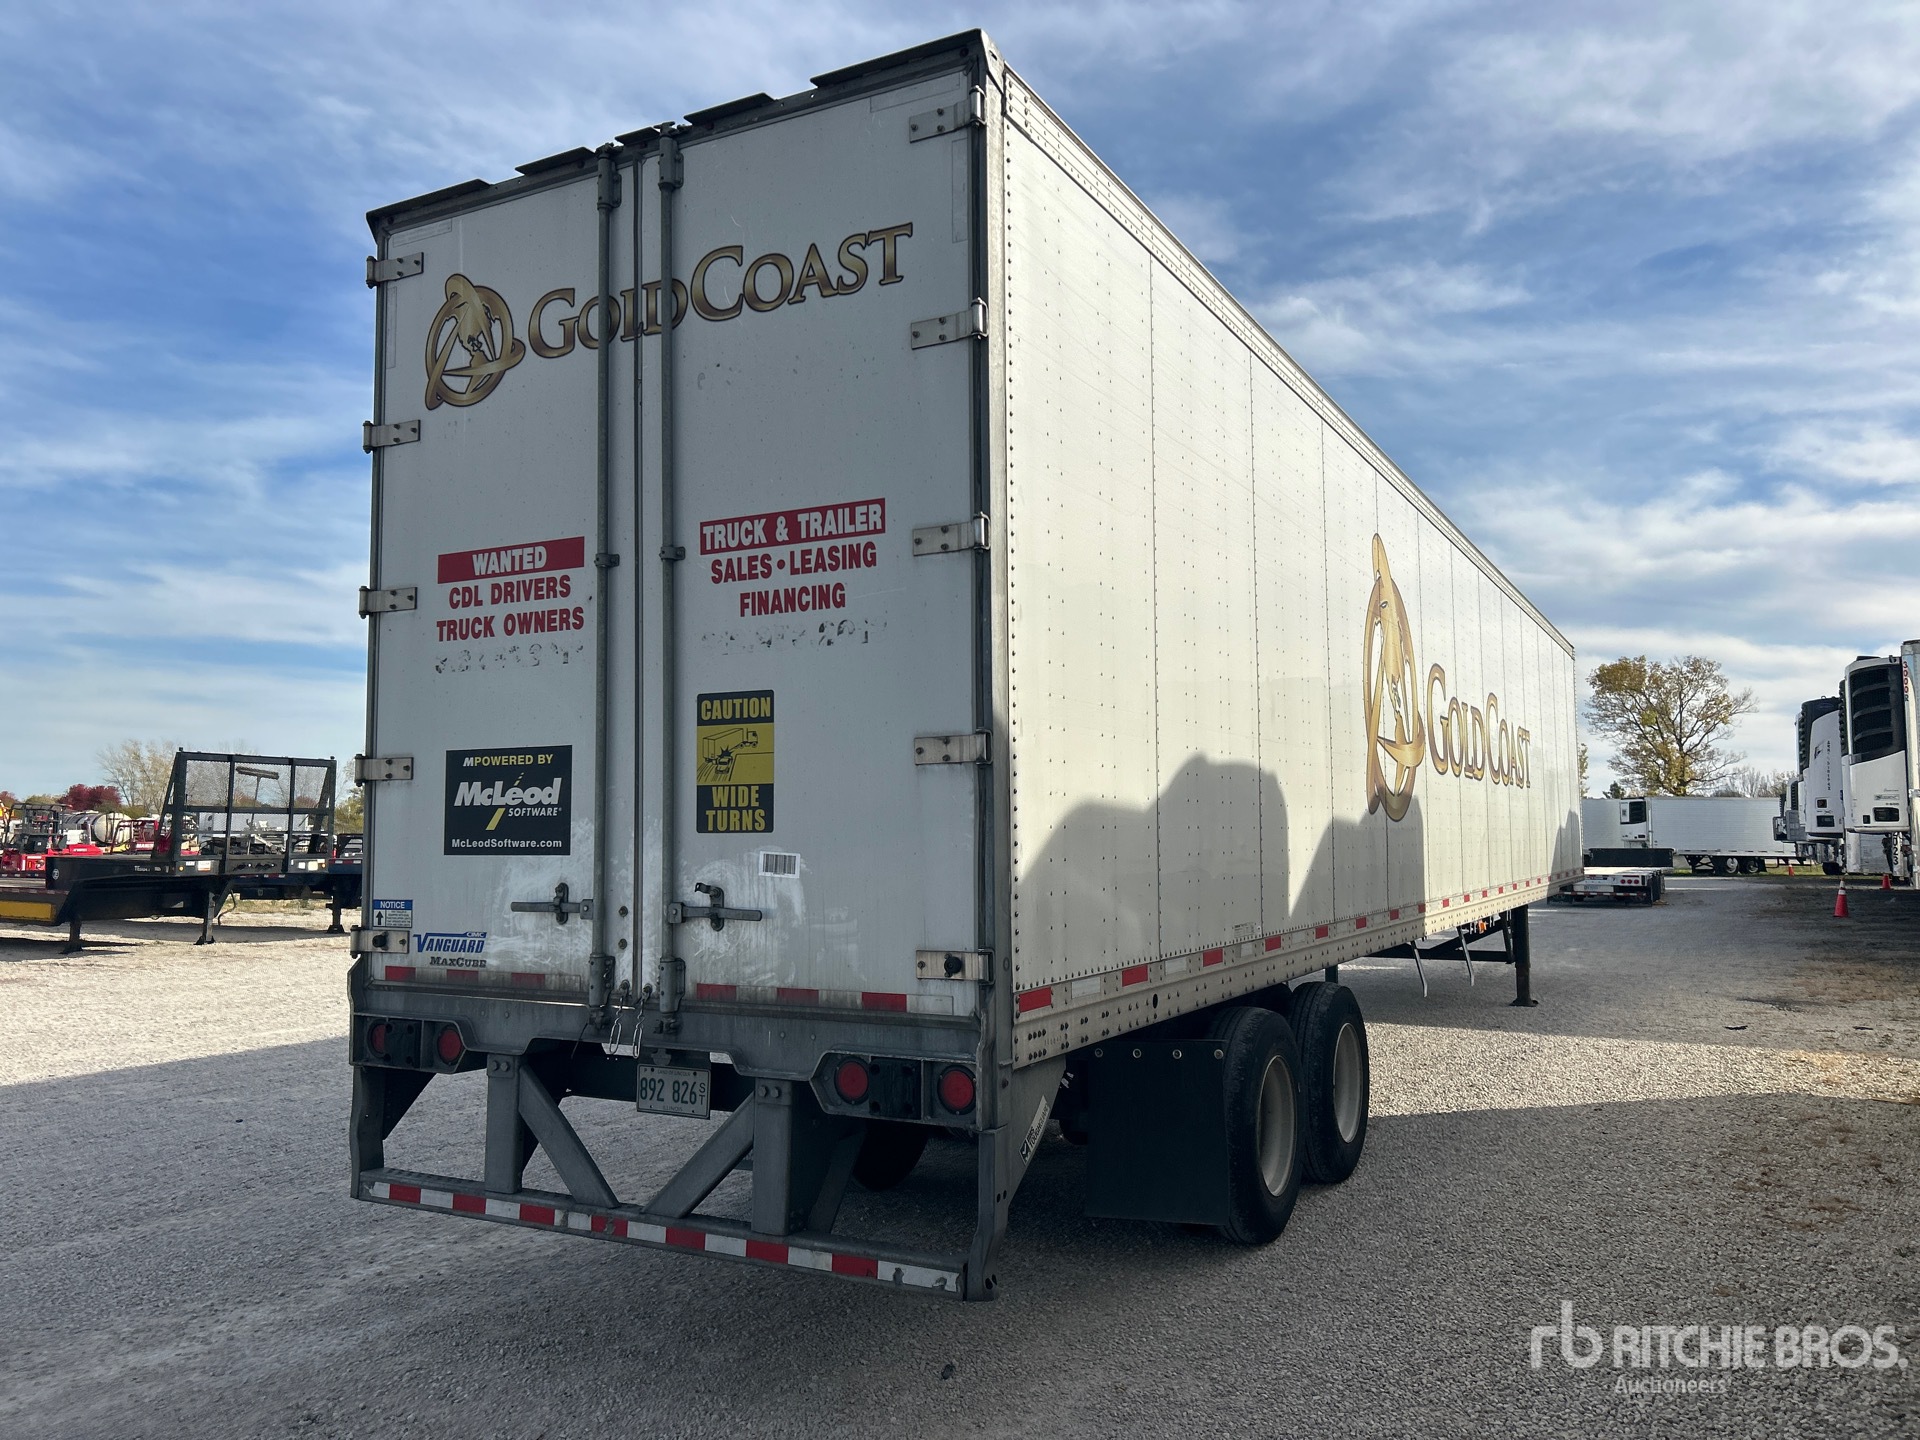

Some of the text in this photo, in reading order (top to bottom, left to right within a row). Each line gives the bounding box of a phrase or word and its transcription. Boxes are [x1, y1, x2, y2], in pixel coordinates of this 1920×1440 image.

[702, 503, 883, 551] TRUCK & TRAILER
[472, 545, 548, 576] WANTED
[711, 541, 877, 585] SALES LEASING
[449, 574, 571, 610] CDL DRIVERS
[739, 582, 846, 618] FINANCING
[436, 606, 585, 642] TRUCK OWNERS
[700, 696, 771, 721] CAUTION
[463, 753, 554, 767] MPOWERED BY
[712, 785, 760, 808] WIDE
[705, 809, 767, 832] TURNS
[451, 838, 563, 848] McLeodSoftware.com
[380, 901, 406, 909] NOTICE
[640, 1077, 665, 1102] 892
[672, 1080, 697, 1105] 826
